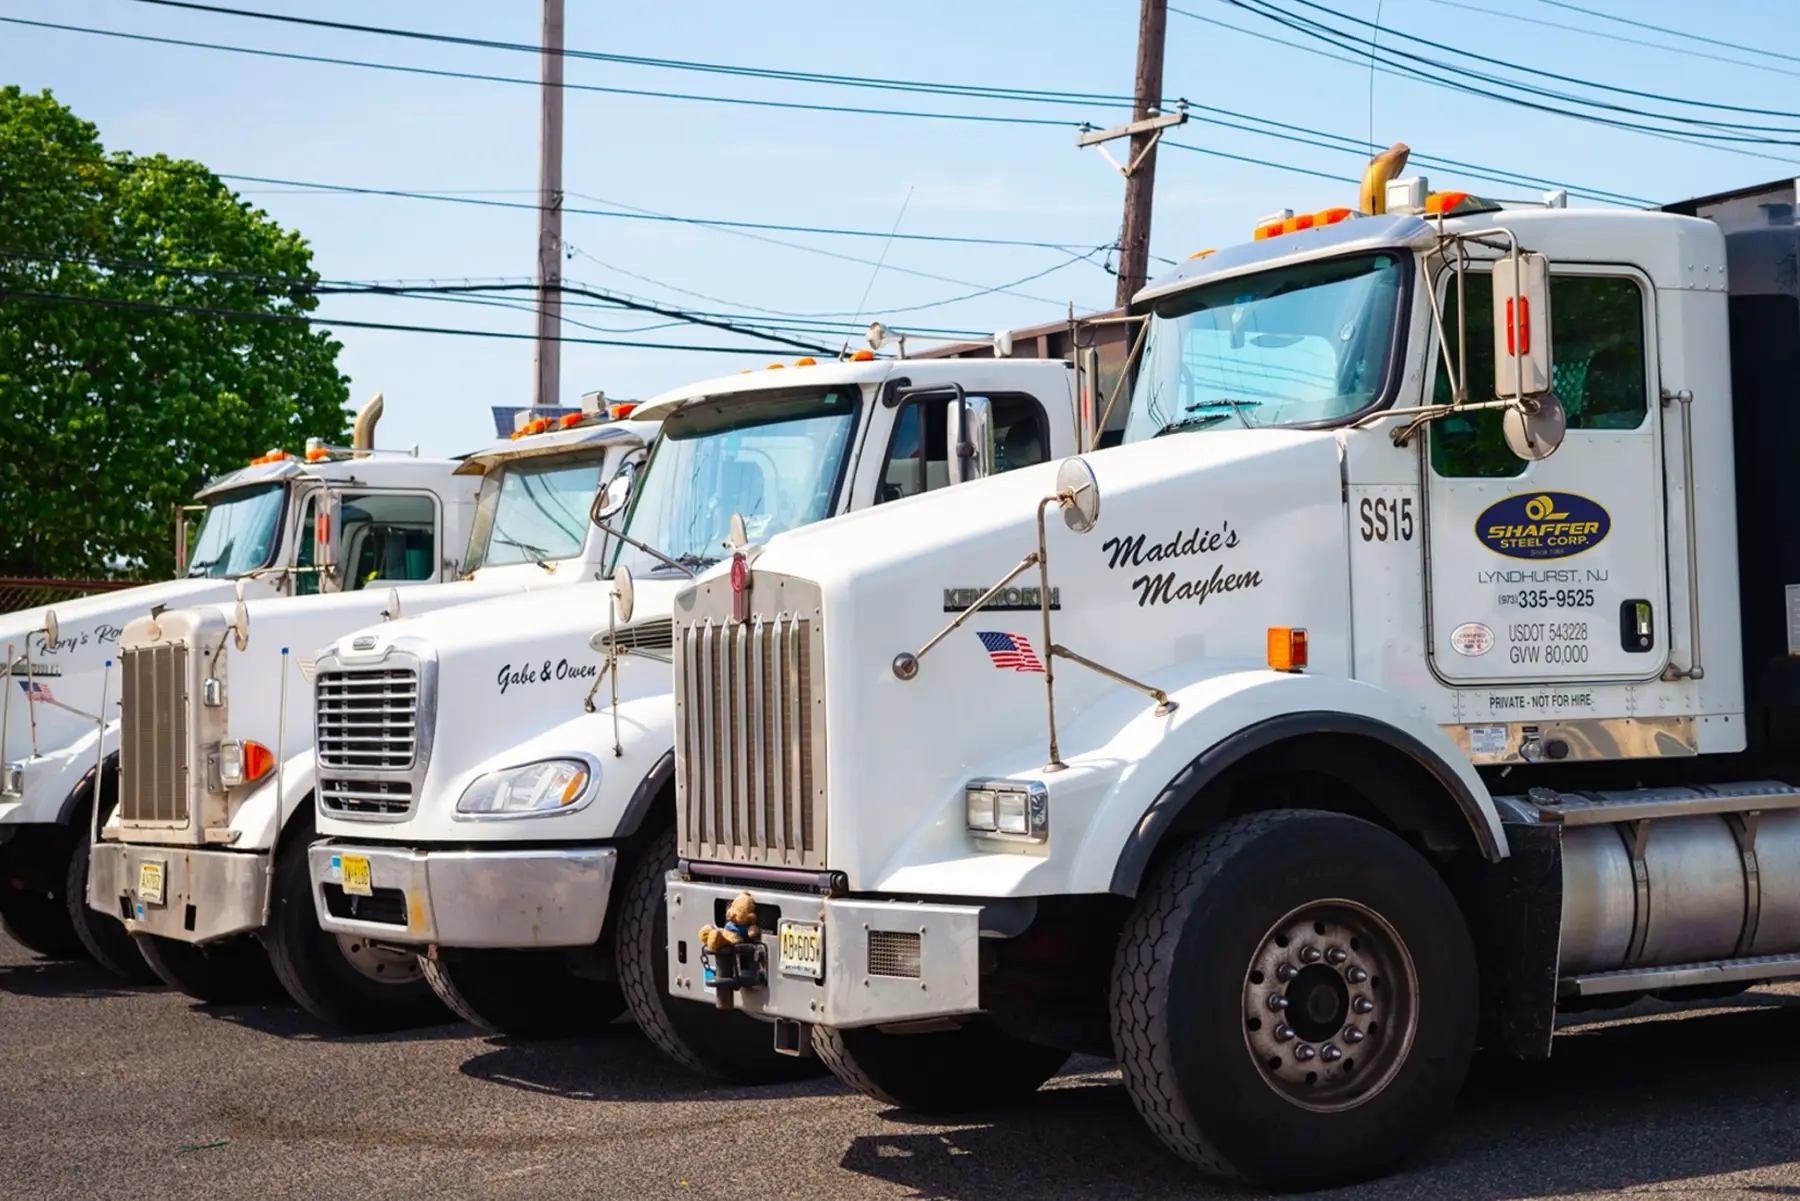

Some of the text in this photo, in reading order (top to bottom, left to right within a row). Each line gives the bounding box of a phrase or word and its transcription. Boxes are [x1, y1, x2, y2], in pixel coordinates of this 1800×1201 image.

[1361, 498, 1413, 541] SS15
[1488, 522, 1599, 538] SHAFFER
[1102, 520, 1240, 569] Maddie's
[1501, 536, 1590, 548] STEEL CORP.
[1132, 564, 1263, 607] Mayhem
[1478, 569, 1608, 583] LYNDHURST, NJ
[1509, 622, 1588, 642] USDOT 543228
[1510, 645, 1588, 666] GVW 80,000
[497, 658, 597, 695] Gabe & Owen
[1489, 696, 1525, 709] PRIVATE
[1532, 695, 1550, 707] NOT
[1552, 694, 1570, 707] FOR
[1571, 693, 1592, 706] HIRE
